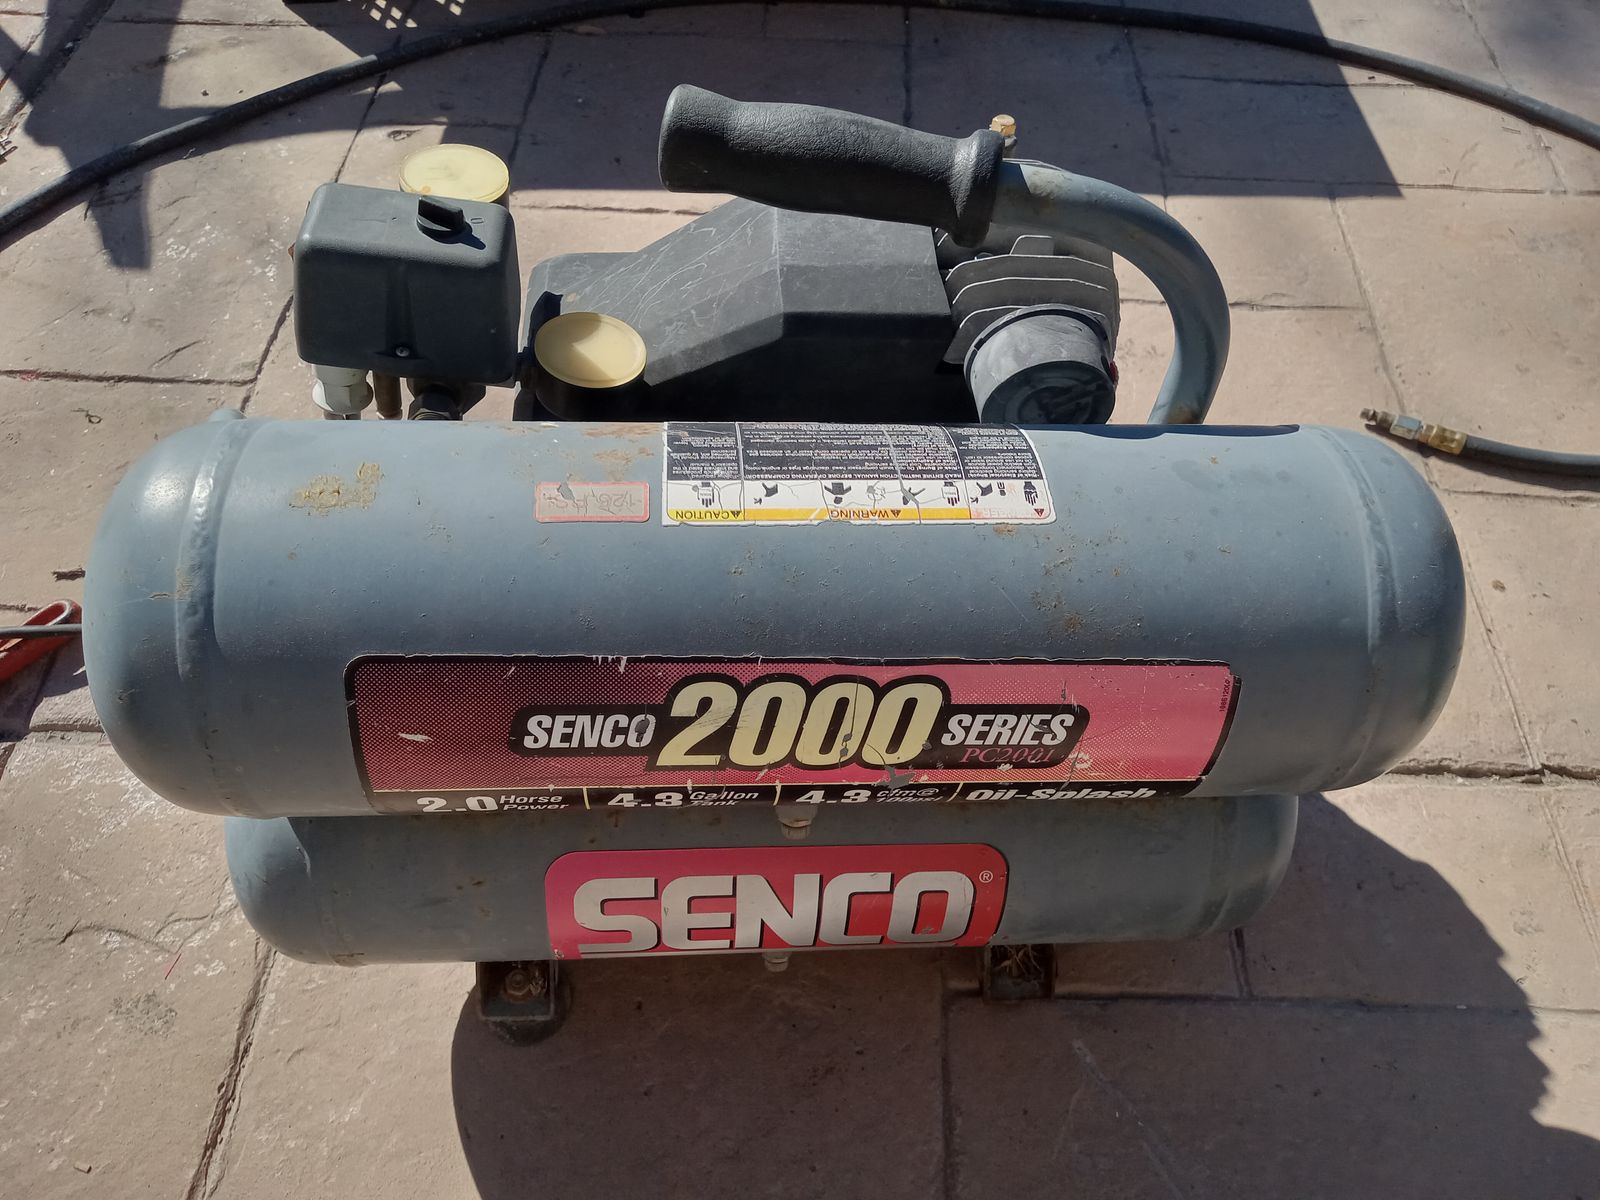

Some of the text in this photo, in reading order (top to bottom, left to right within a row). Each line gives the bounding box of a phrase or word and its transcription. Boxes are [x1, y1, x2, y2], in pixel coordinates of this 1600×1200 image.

[676, 511, 729, 519] CAUTION
[831, 510, 889, 519] WARNING
[523, 681, 1075, 767] SENCO 2000 SERIES
[959, 747, 1054, 763] PC2001
[607, 791, 759, 807] 4.3 Gallon
[796, 789, 872, 804] 4.3
[966, 788, 1157, 801] Oil-Splash
[416, 795, 562, 812] 2.0 Horse
[573, 871, 975, 953] SENCO
